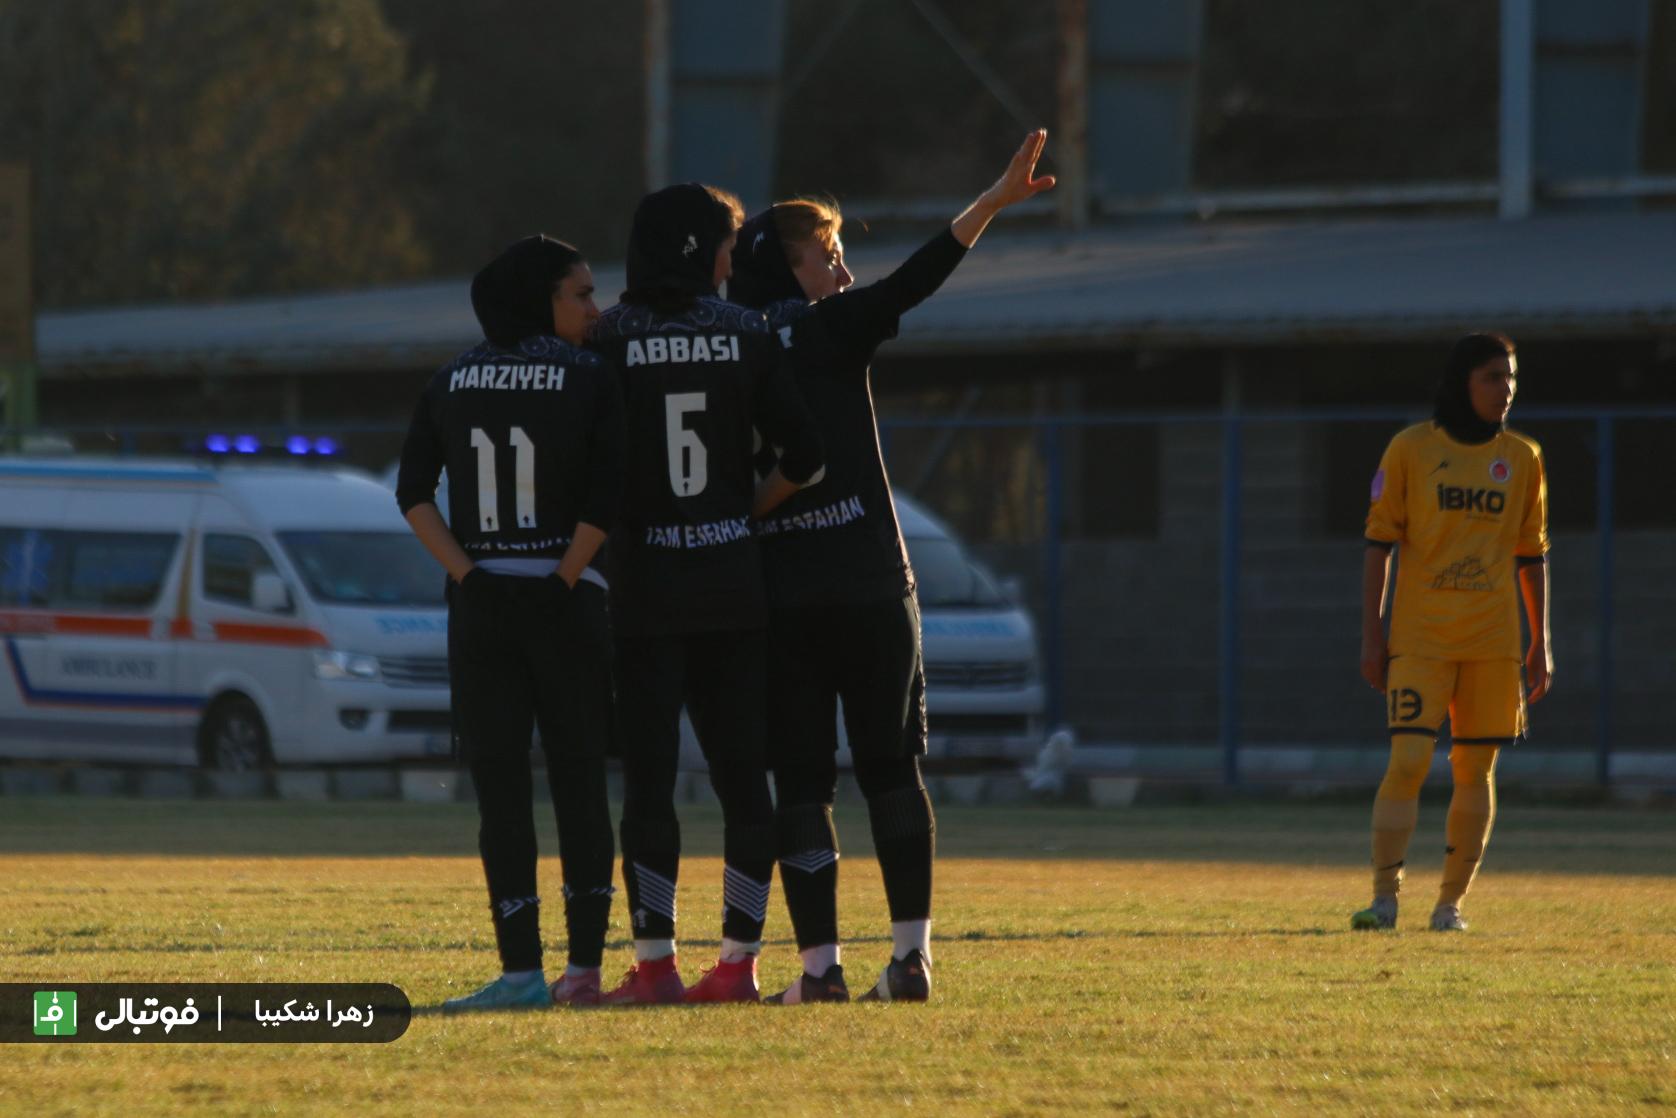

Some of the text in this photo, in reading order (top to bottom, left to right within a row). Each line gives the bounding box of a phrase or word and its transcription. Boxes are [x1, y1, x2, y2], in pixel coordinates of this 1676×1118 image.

[626, 334, 740, 367] ABBASI
[449, 363, 566, 393] MARZIYEH
[664, 392, 708, 498] 6
[470, 426, 537, 533] 11
[1389, 688, 1423, 723] 13
